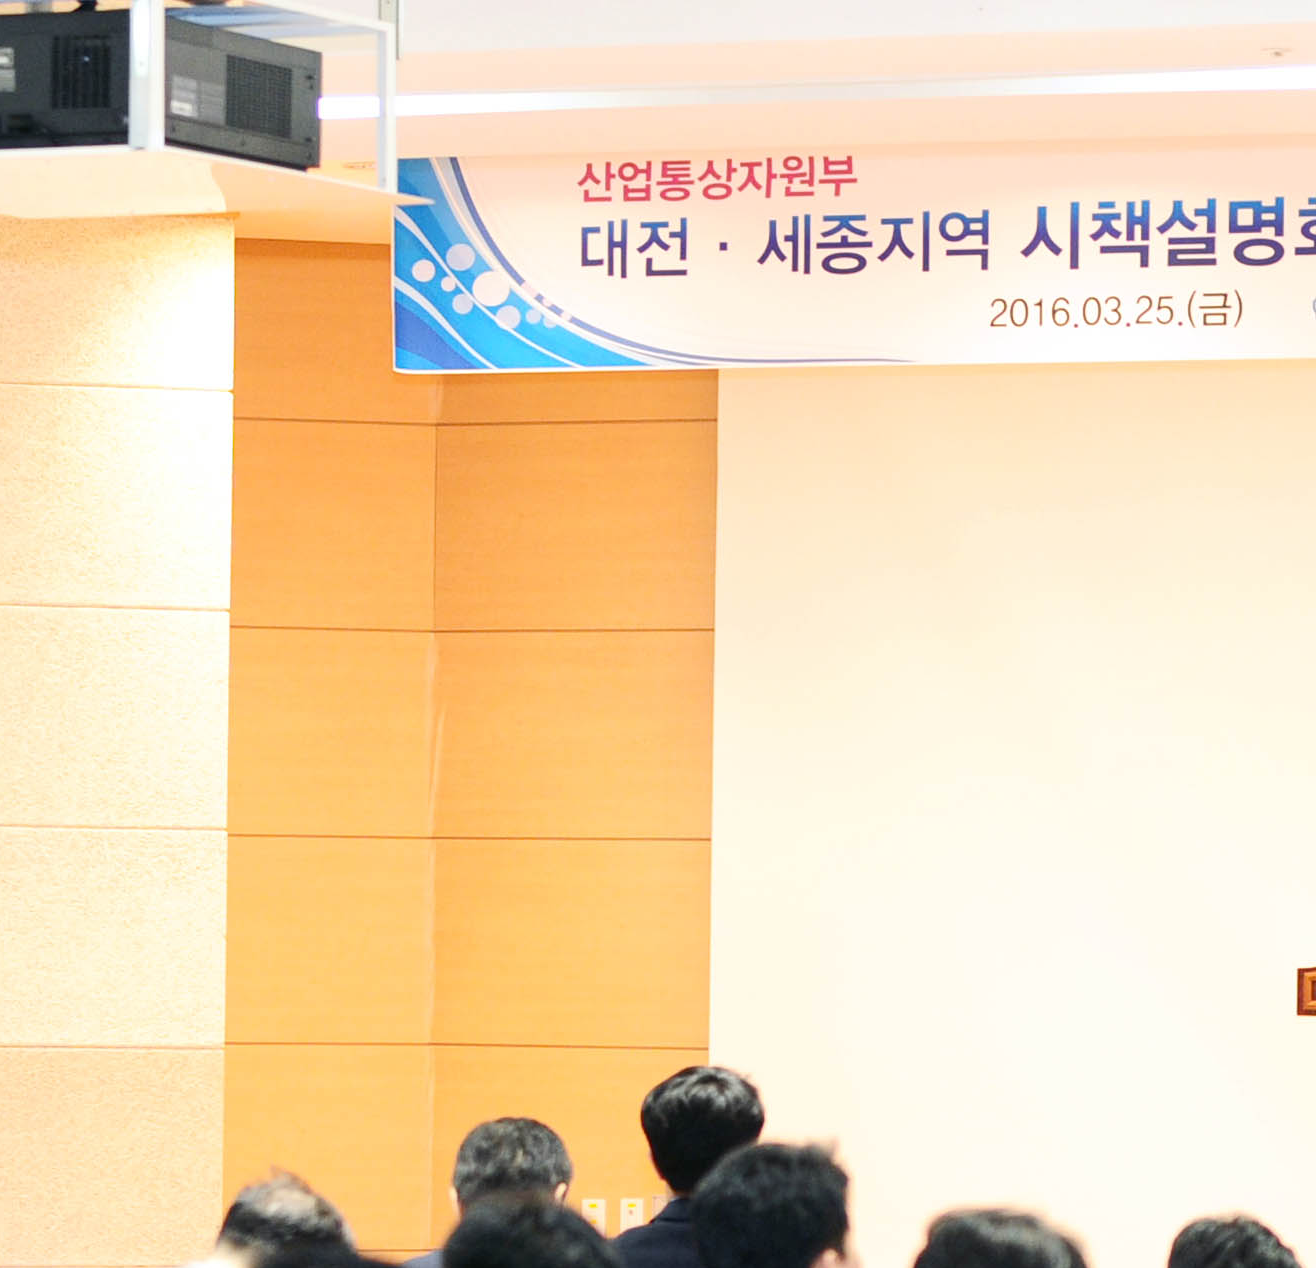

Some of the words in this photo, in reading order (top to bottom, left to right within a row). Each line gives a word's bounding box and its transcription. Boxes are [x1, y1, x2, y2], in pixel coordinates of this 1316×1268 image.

[577, 155, 859, 203] 산업통상자원부
[580, 215, 691, 279] 대전
[756, 208, 991, 275] 세종지역
[989, 290, 1244, 330] 2016.03.25.(금)
